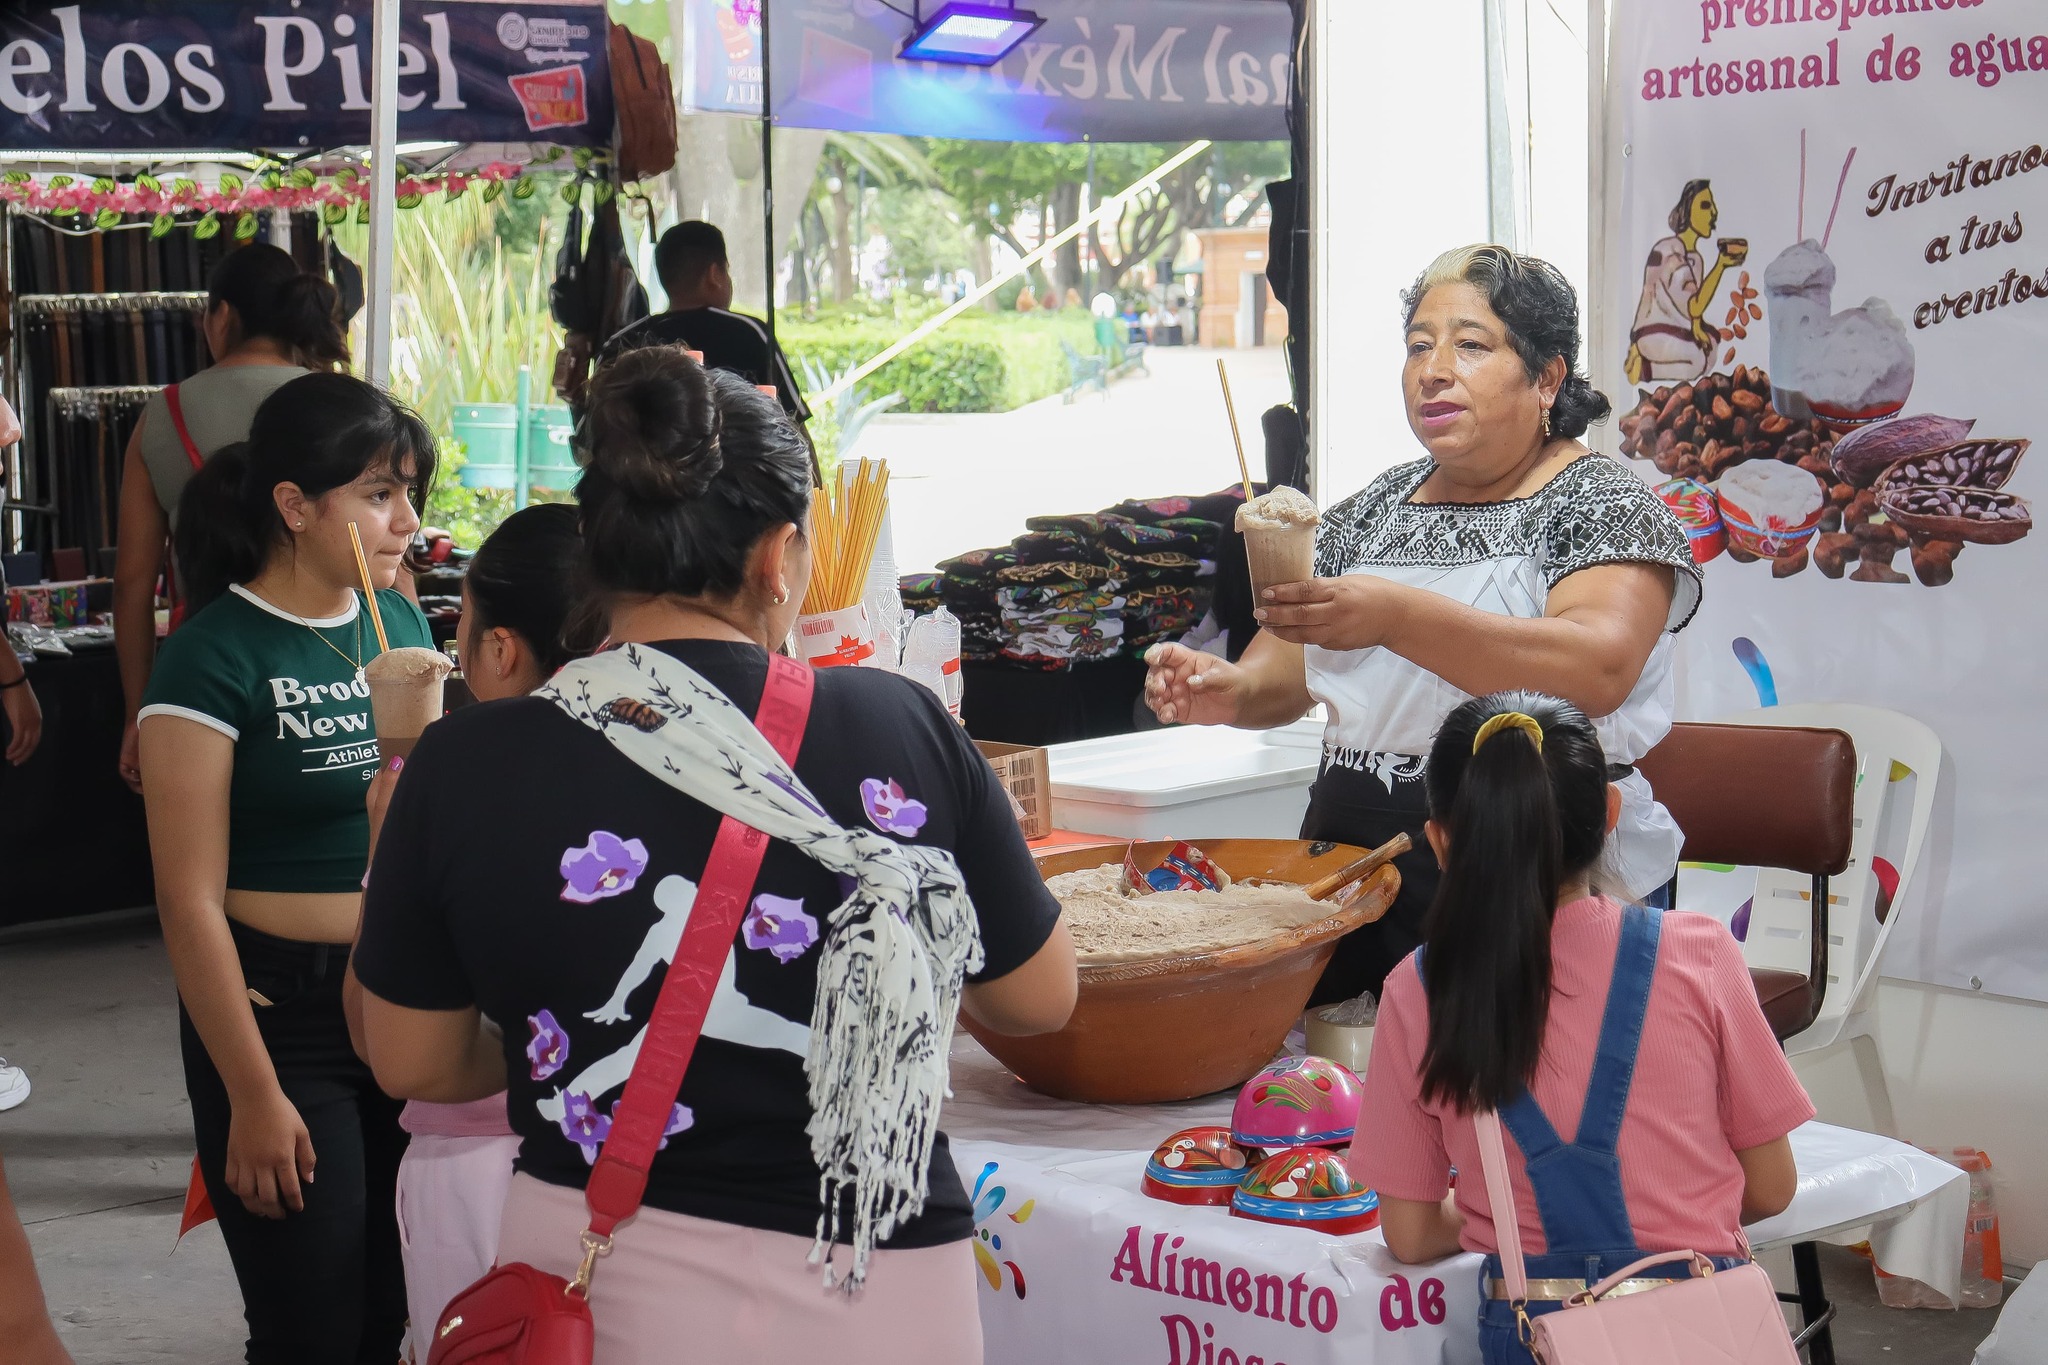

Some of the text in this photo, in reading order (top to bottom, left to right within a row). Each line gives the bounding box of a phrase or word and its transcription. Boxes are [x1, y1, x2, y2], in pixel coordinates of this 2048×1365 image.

[254, 12, 467, 113] Piel
[1641, 33, 2048, 100] artesanal de agua
[1866, 144, 2048, 218] Invitano
[1923, 211, 2023, 265] a tus
[277, 711, 367, 739] New
[325, 745, 380, 765] Athlet
[1336, 747, 1377, 774] 2024
[1109, 1225, 1446, 1334] Alimento de
